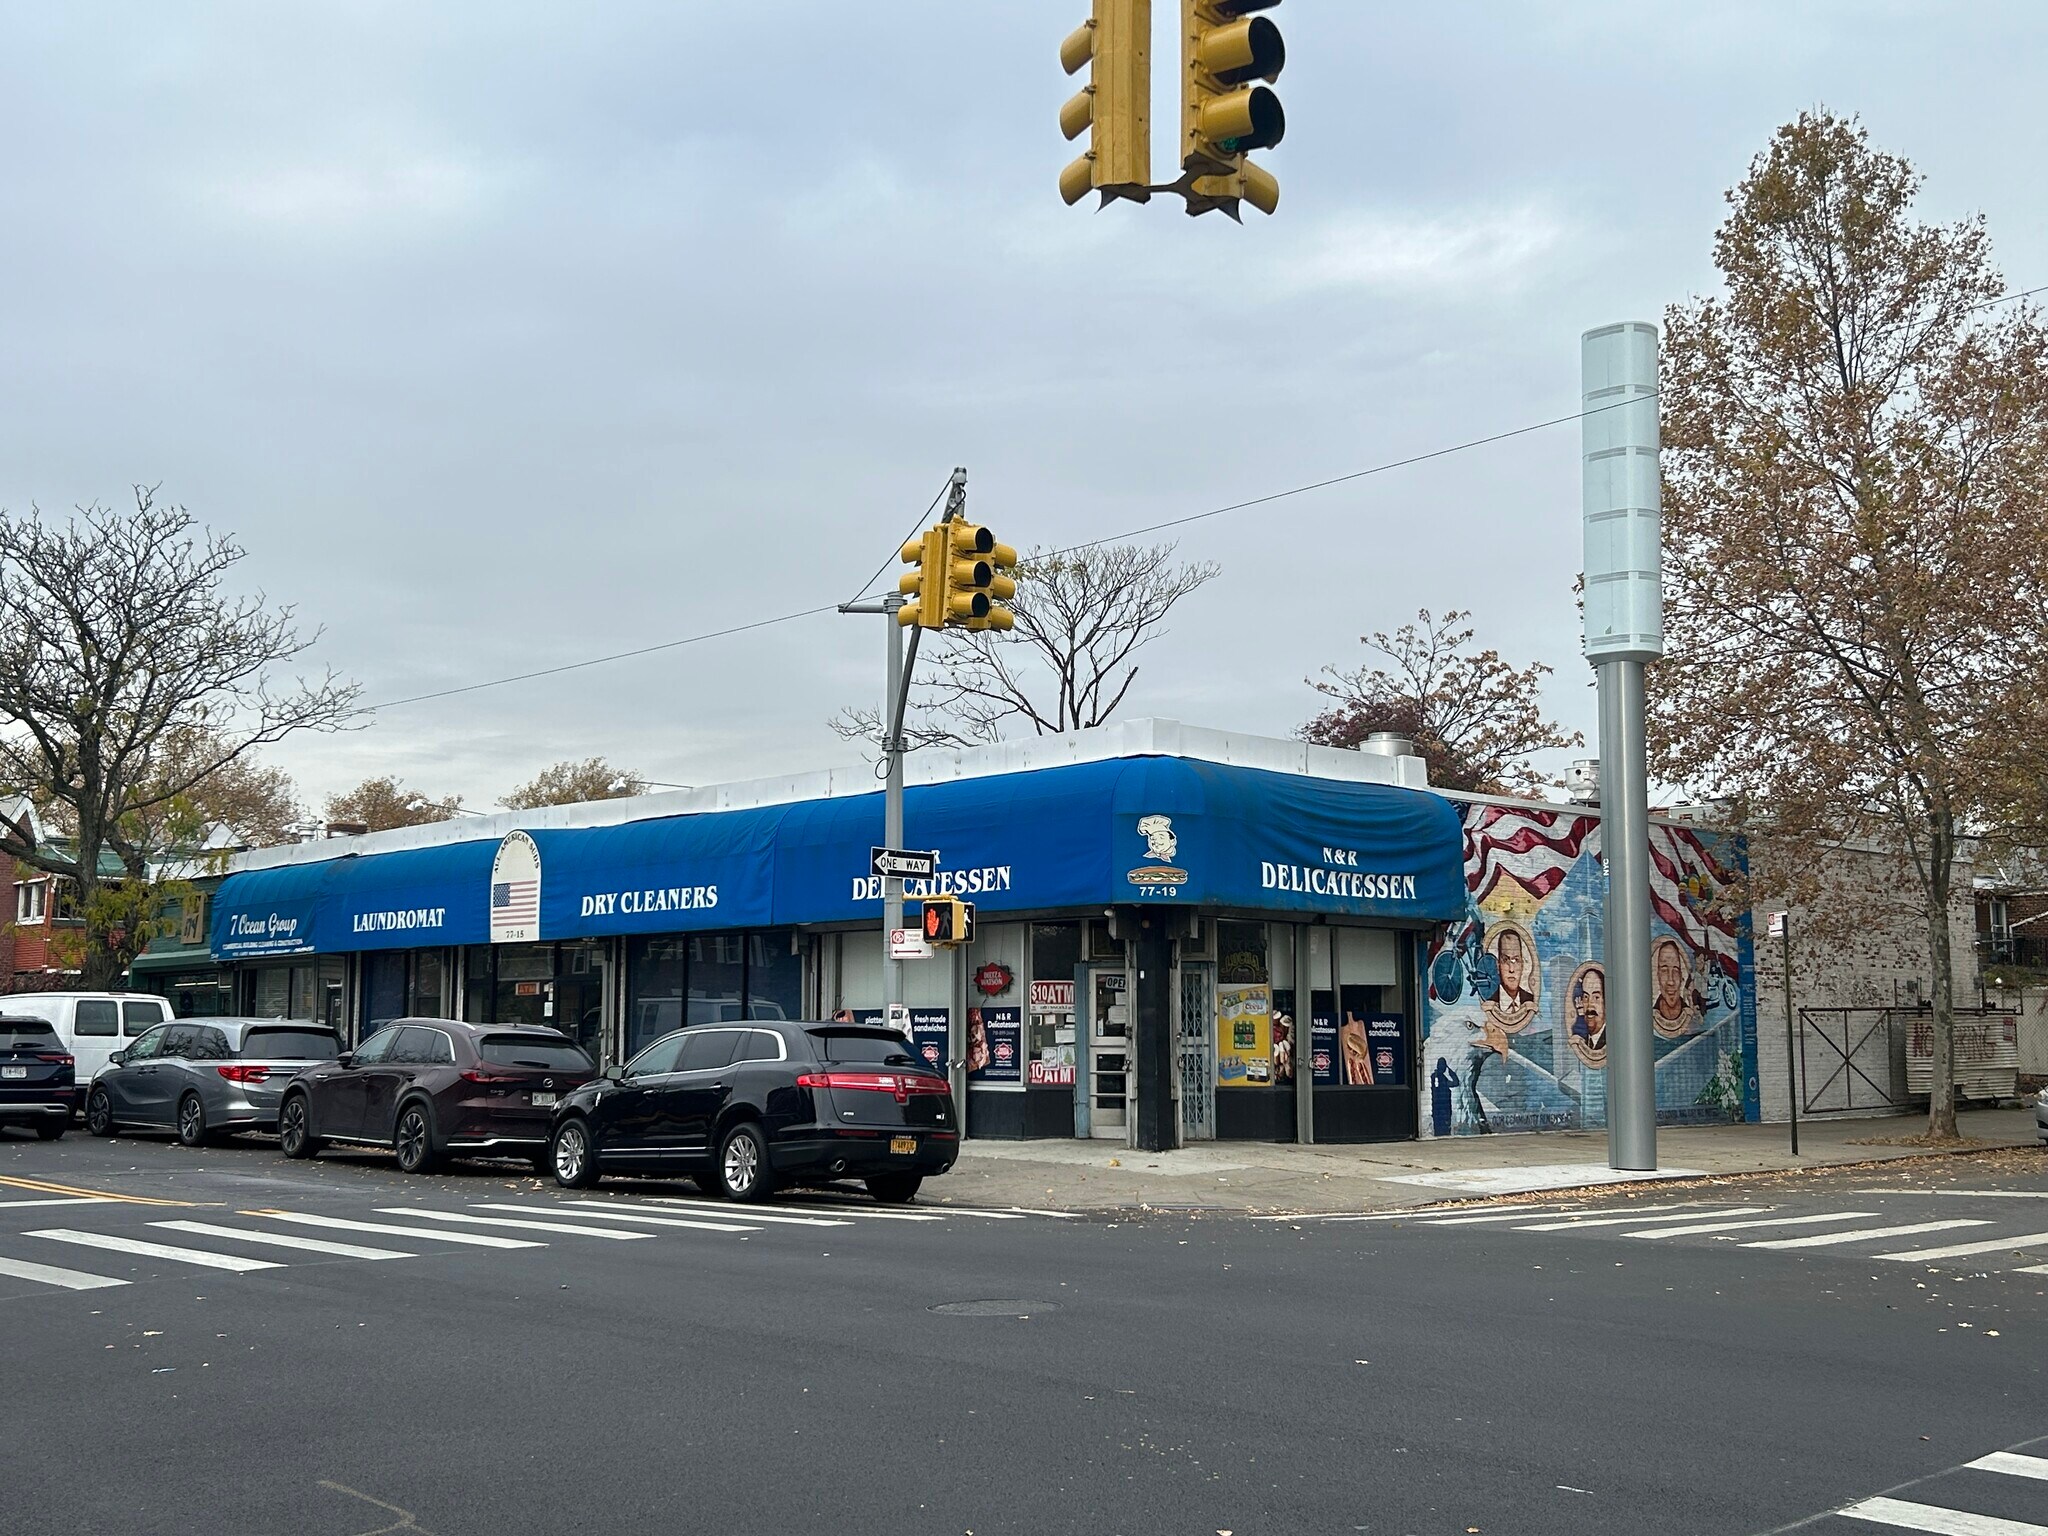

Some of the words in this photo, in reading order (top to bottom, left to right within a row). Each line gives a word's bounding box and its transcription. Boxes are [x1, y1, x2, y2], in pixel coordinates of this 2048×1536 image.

[500, 832, 529, 853] AMERICAN
[528, 843, 540, 870] SUDS
[880, 856, 898, 869] ONE
[905, 859, 927, 871] WAY
[1261, 861, 1417, 900] DELICATESSEN
[1139, 886, 1177, 898] 77-19
[580, 892, 618, 917] DRY
[620, 885, 718, 914] CLEANERS
[230, 914, 239, 936] 7
[238, 914, 267, 935] Ocean
[268, 912, 297, 938] Group
[352, 907, 446, 932] LAUNDROMAT
[505, 930, 525, 939] 77-15
[1031, 984, 1047, 1002] $10
[1047, 984, 1074, 1004] ATM
[914, 1015, 929, 1023] fresh
[929, 1015, 946, 1023] made
[987, 1020, 1020, 1029] Delicatessen
[1371, 1020, 1397, 1029] specialty
[913, 1023, 947, 1032] sandwiches
[1368, 1029, 1400, 1037] sandwiches
